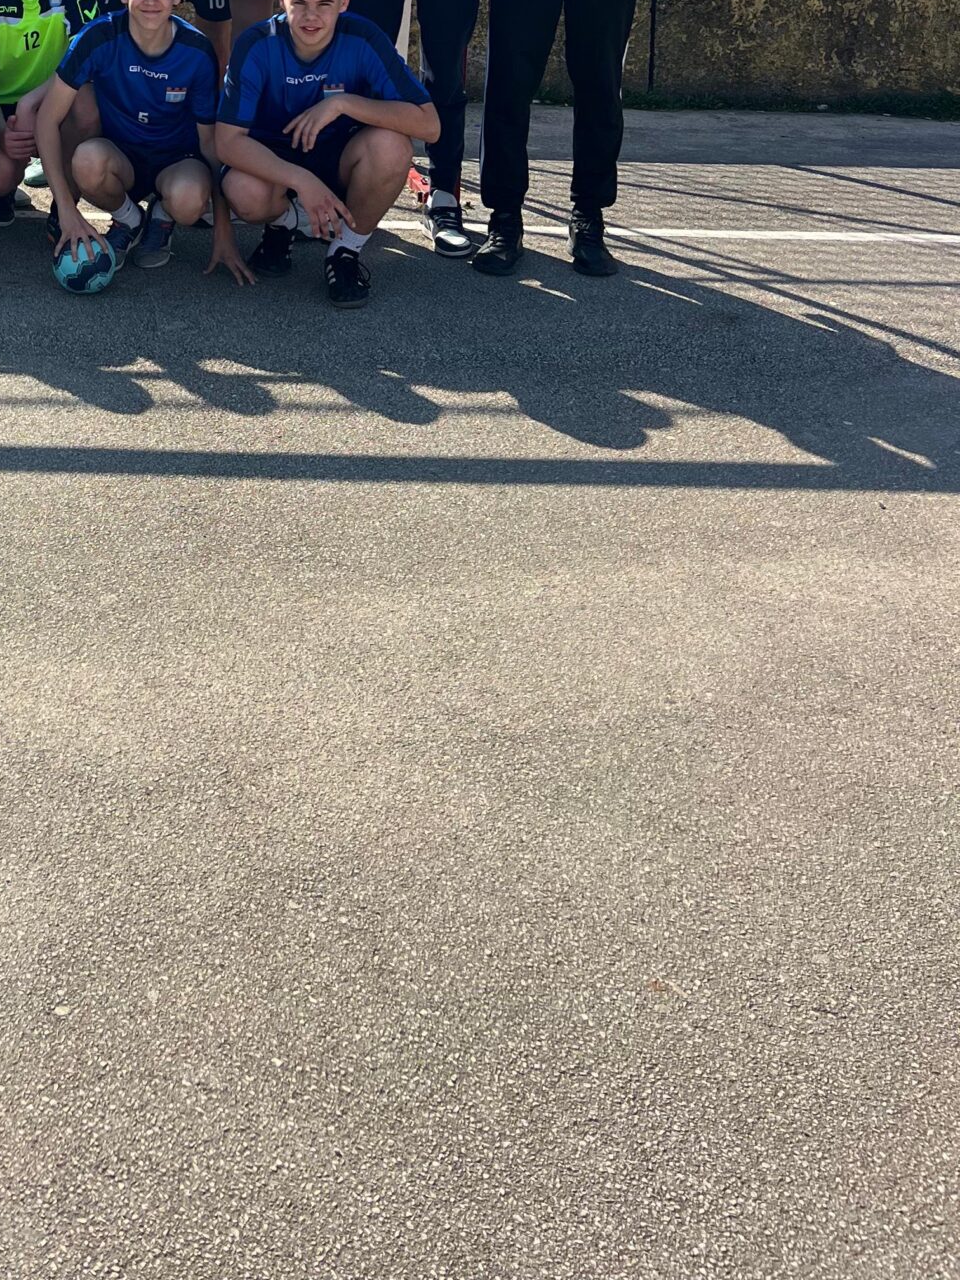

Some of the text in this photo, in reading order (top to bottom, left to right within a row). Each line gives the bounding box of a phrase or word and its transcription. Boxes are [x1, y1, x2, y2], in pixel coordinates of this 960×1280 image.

[23, 31, 41, 51] 12
[129, 65, 169, 81] GIVOVA
[138, 111, 149, 124] 5
